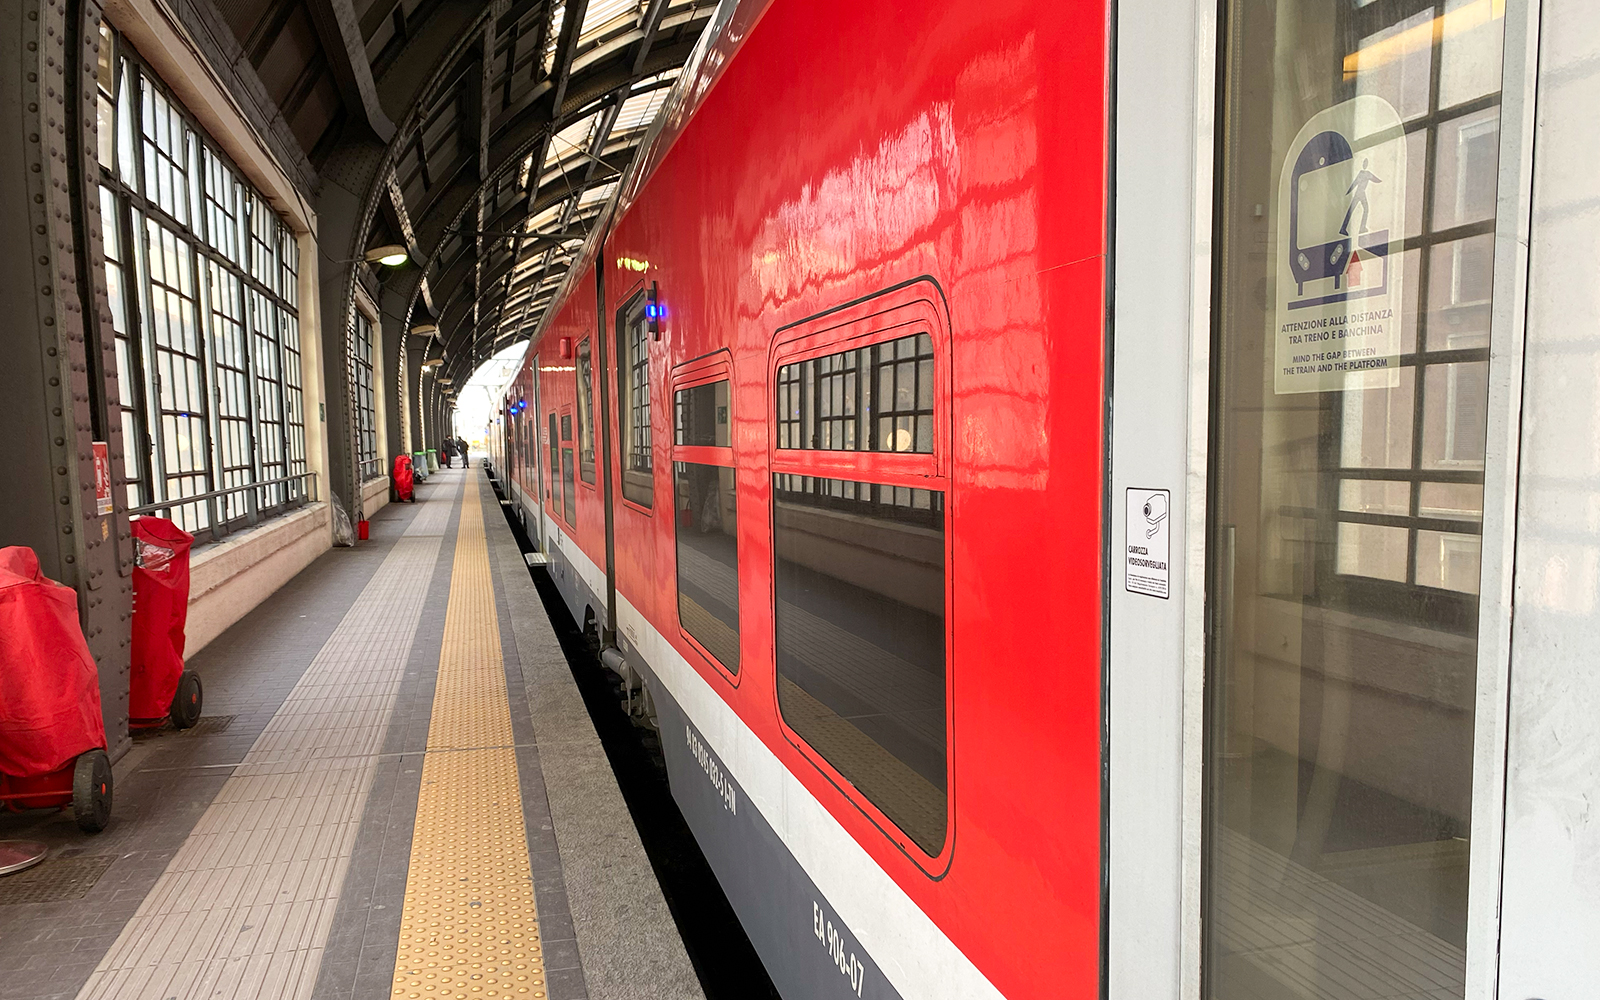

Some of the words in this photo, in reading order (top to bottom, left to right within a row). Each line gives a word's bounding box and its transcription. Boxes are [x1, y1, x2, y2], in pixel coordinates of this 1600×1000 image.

[1281, 318, 1327, 333] ATTENZIONE
[1329, 315, 1348, 327] ALLA
[1350, 308, 1393, 324] DISTANZA
[1289, 335, 1302, 345] TRA
[1304, 331, 1330, 343] TRENO
[1331, 330, 1336, 340] E
[1338, 324, 1383, 339] BANCHINA
[1292, 354, 1310, 363] MIND
[1312, 352, 1325, 361] THE
[1326, 351, 1341, 361] GAP
[1343, 347, 1376, 359] BETWEEN
[1283, 367, 1295, 376] THE
[1296, 365, 1316, 375] TRAIN
[1317, 363, 1333, 373] AND
[1334, 361, 1348, 371] THE
[1349, 358, 1388, 370] PLATFORM
[1128, 545, 1148, 555] CARROZZA
[1128, 557, 1167, 570] VIDEOSORVEGLIATA
[813, 900, 826, 947] EA
[827, 920, 865, 998] 906-07
